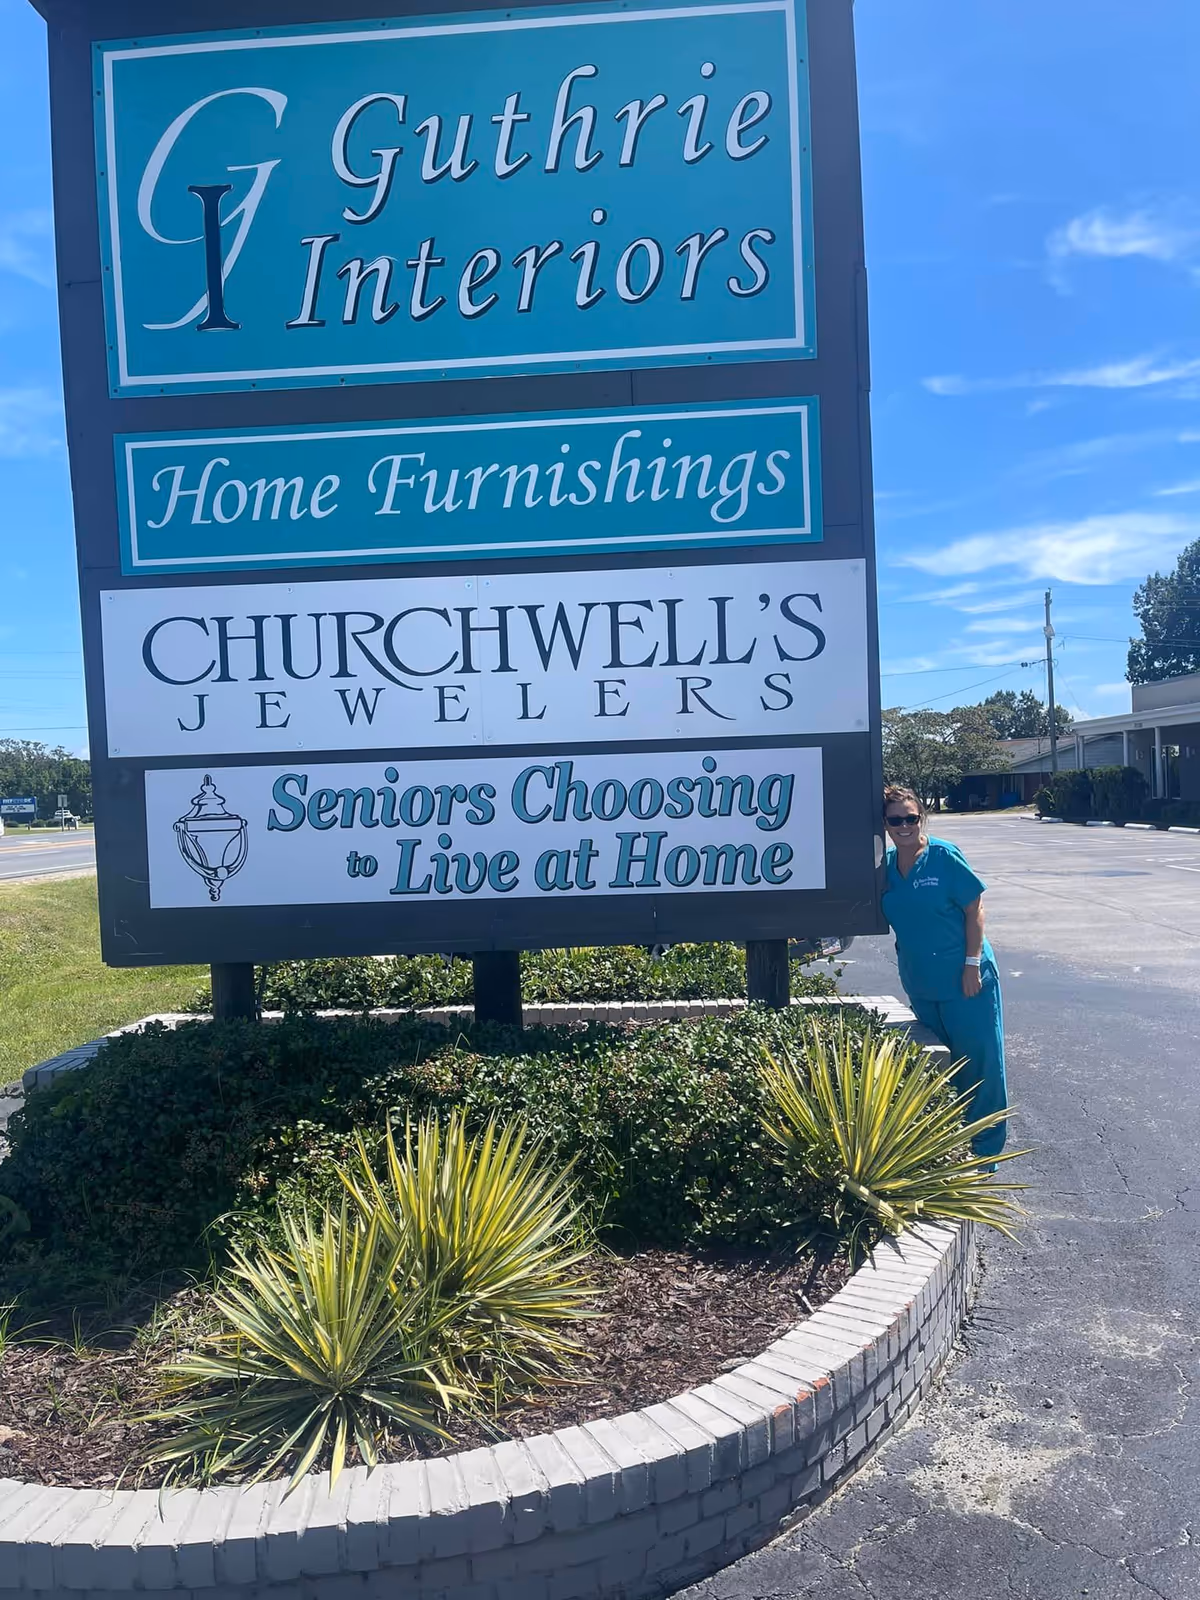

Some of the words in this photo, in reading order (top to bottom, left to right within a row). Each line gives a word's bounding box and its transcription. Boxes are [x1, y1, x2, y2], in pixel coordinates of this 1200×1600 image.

[330, 63, 774, 224] Guthrie
[285, 208, 776, 329] Interiors
[147, 457, 340, 529] Home
[367, 429, 791, 525] Furnishings
[141, 592, 826, 692] CHURCHWELL'S
[177, 672, 795, 733] JEWELERS
[267, 767, 496, 833] Seniors
[510, 757, 795, 831] Choosing
[346, 850, 378, 879] to
[390, 838, 519, 896] Live
[533, 841, 599, 891] at
[608, 831, 794, 889] Home
